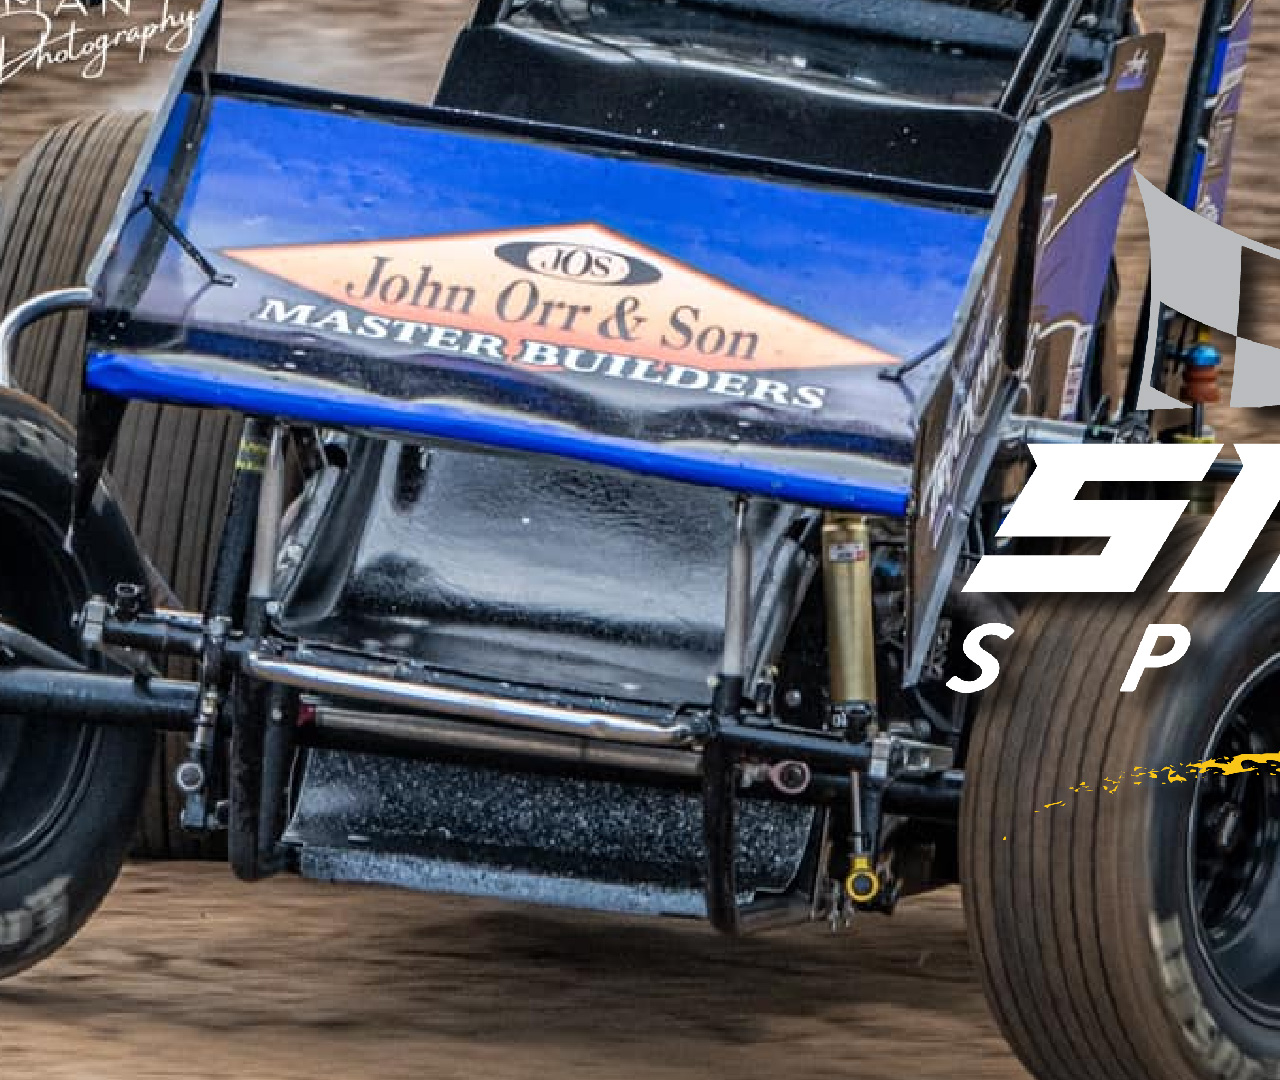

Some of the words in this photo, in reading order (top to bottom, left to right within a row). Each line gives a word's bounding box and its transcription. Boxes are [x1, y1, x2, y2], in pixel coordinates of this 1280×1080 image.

[344, 255, 476, 318] John
[495, 279, 591, 332] Orr
[599, 295, 647, 342] &
[660, 305, 760, 360] Son
[540, 245, 614, 277] JOS
[255, 296, 508, 362] MASTER
[521, 343, 827, 410] BUILDERS
